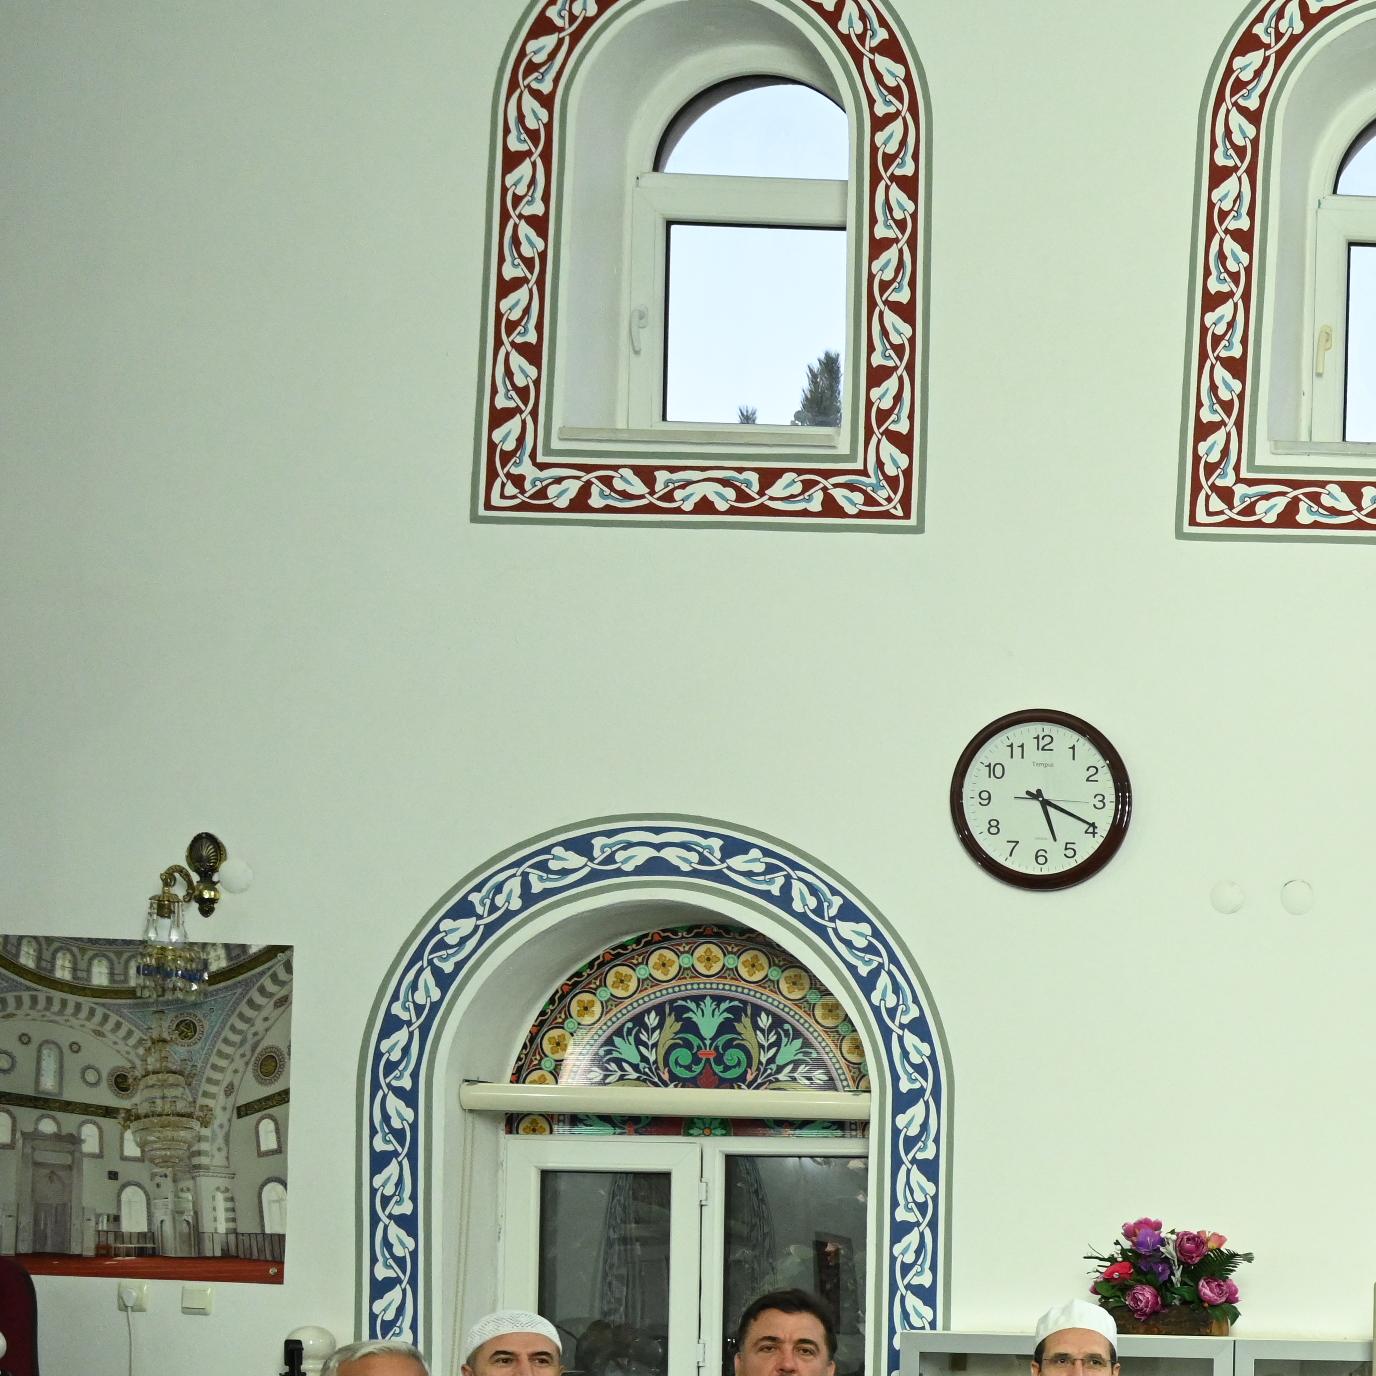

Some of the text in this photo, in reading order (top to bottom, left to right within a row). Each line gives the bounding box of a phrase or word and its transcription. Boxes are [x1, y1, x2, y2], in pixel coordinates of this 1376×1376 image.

[1006, 743, 1024, 759] 11
[1033, 735, 1054, 751] 12
[1068, 745, 1076, 760] 1
[985, 762, 1005, 779] 10
[1086, 766, 1099, 782] 2
[978, 790, 991, 806] 9
[1093, 793, 1106, 810] 3
[987, 819, 1000, 835] 8
[1085, 822, 1098, 838] 4
[1006, 840, 1019, 857] 7
[1063, 842, 1076, 858] 5
[1035, 849, 1048, 865] 6
